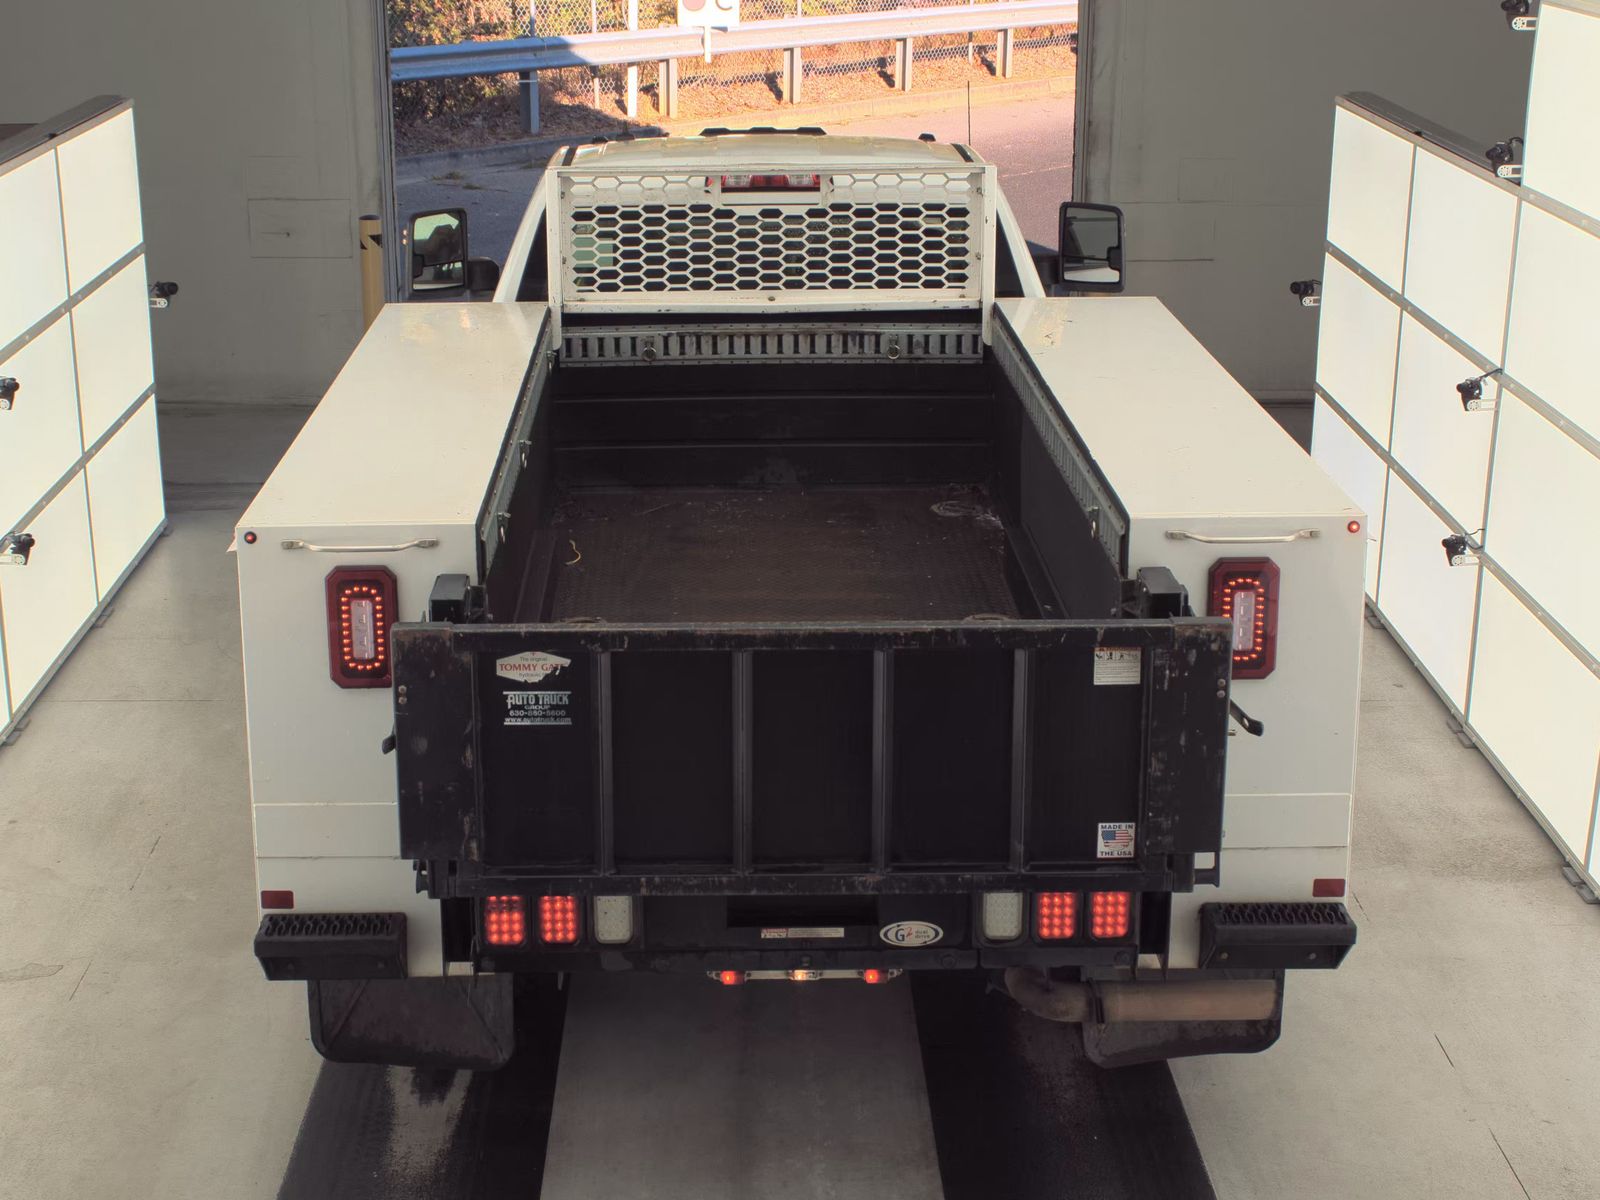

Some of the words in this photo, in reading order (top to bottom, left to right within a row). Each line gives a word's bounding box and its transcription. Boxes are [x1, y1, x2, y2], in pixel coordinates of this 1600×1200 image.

[499, 663, 538, 671] TOMMY
[506, 694, 535, 708] AUTO
[538, 694, 569, 705] TRUCK
